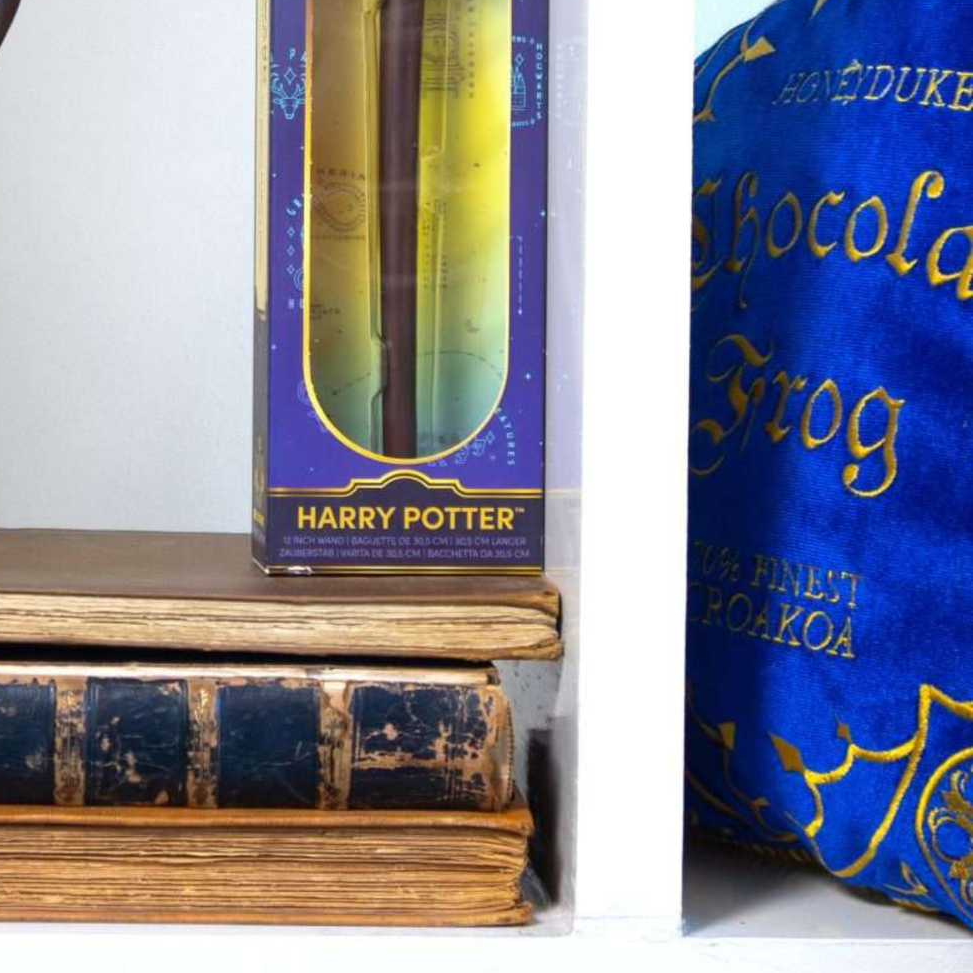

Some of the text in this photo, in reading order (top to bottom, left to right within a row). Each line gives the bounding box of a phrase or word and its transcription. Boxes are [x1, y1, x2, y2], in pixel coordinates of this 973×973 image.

[298, 507, 395, 529] HARRY
[294, 536, 315, 546] INCH
[317, 536, 345, 546] WAND
[749, 554, 861, 609] FINEST
